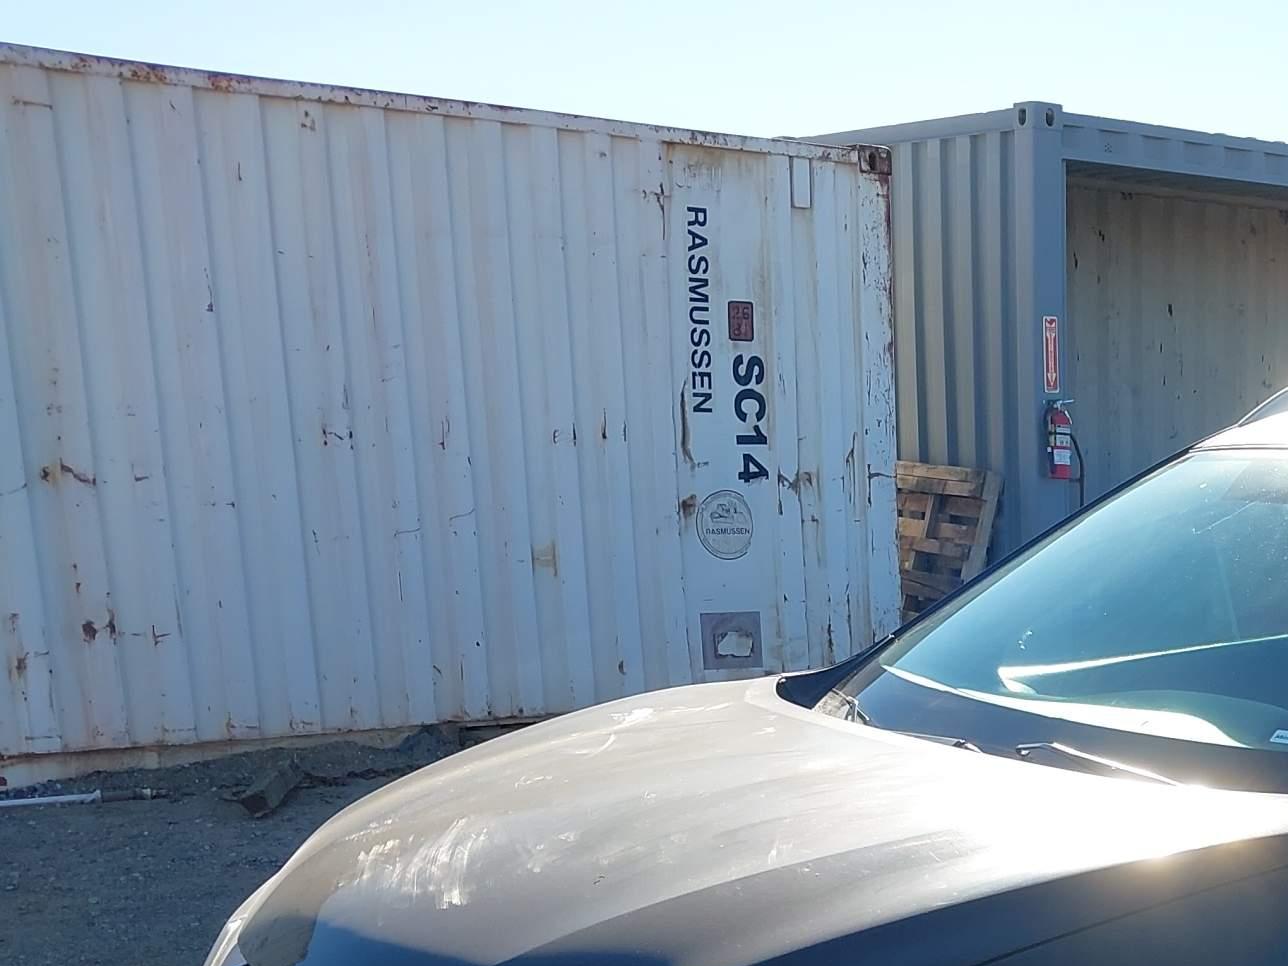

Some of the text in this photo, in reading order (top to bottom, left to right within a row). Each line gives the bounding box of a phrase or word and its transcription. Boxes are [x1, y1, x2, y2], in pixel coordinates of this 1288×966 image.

[686, 206, 713, 414] RASMUSSEN
[732, 353, 769, 484] SC14
[705, 527, 751, 536] RASMUSSEN
